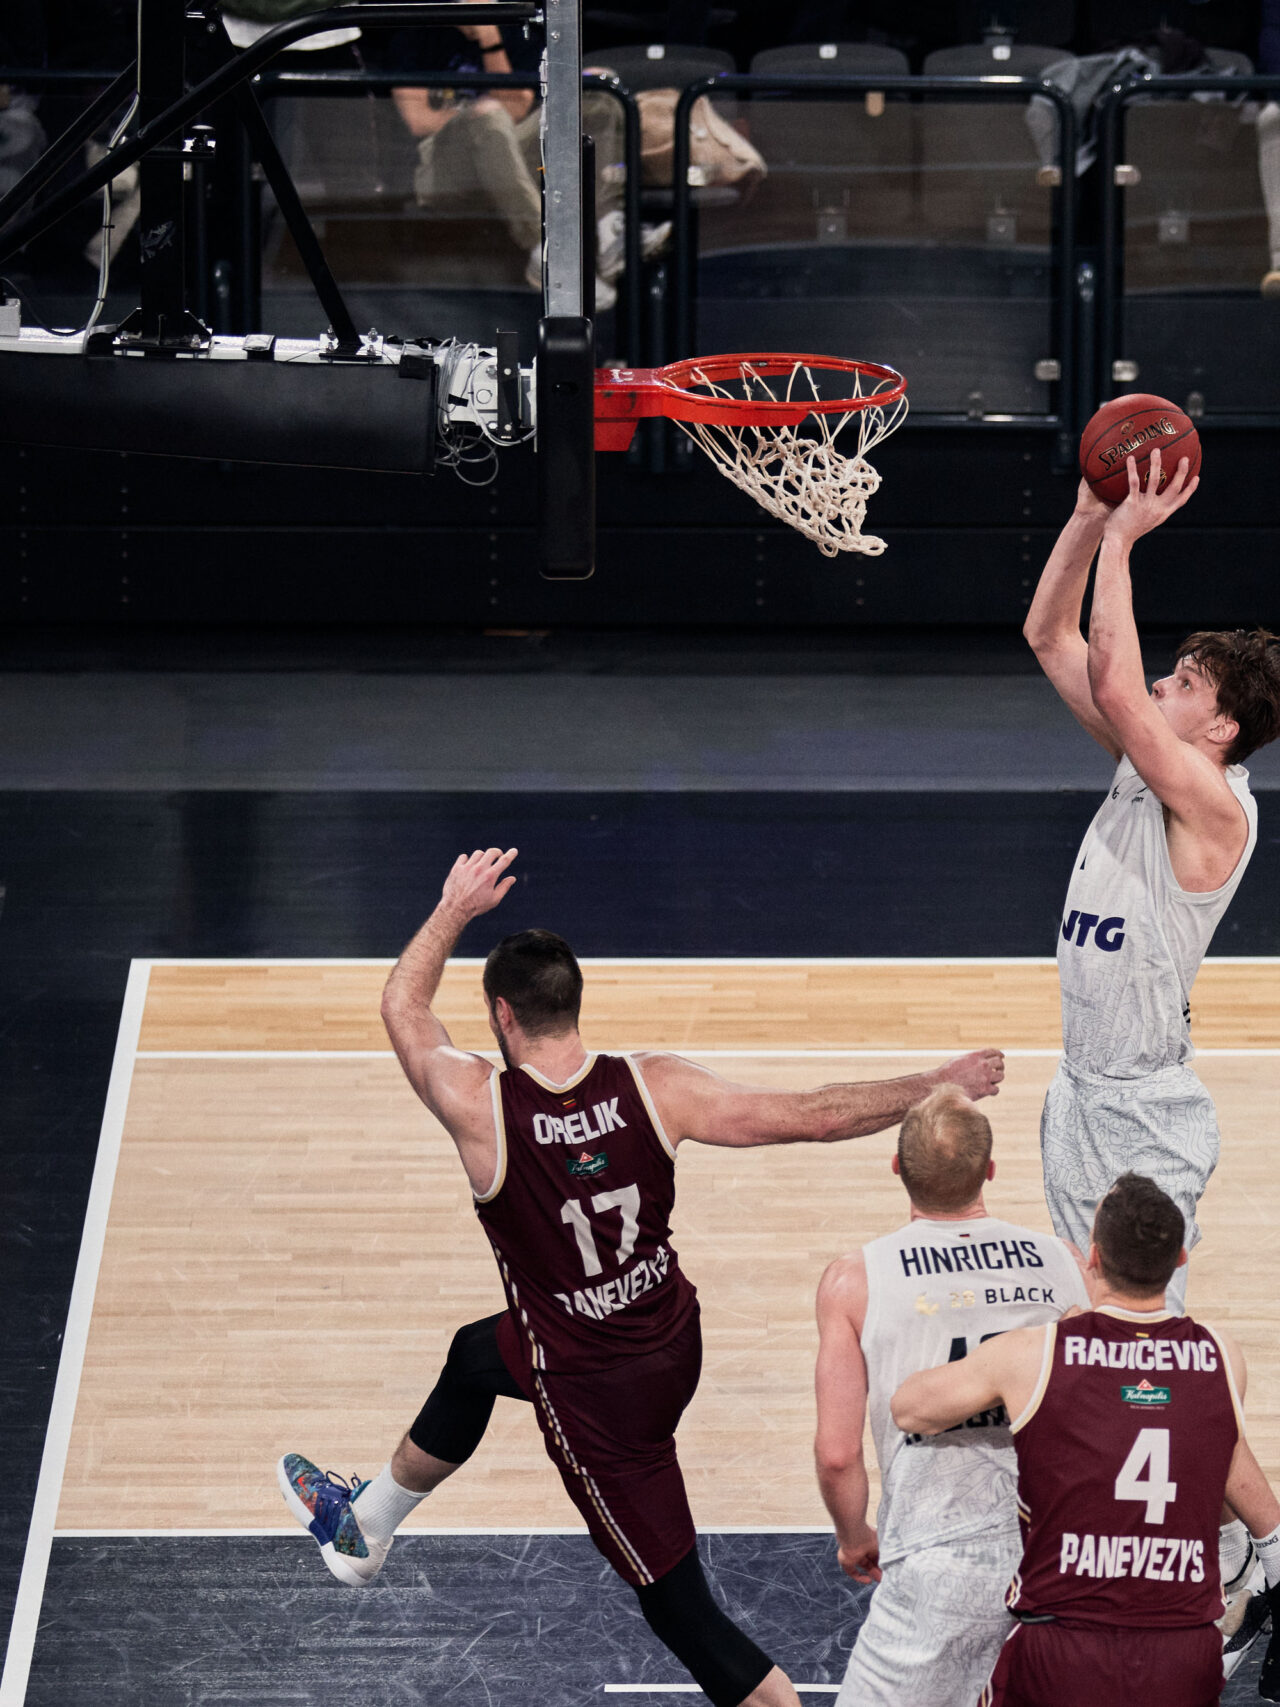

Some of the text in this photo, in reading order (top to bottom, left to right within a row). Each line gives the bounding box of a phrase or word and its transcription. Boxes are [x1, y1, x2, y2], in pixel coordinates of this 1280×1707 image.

[1098, 417, 1176, 471] SPALDING
[532, 1096, 628, 1145] ORELIK
[559, 1182, 641, 1278] 17
[900, 1240, 1044, 1277] HINRICHS
[984, 1287, 1055, 1304] BLACK
[1064, 1336, 1218, 1372] RADICEVIC
[1114, 1428, 1178, 1525] 4
[1059, 1533, 1205, 1583] PANEVEZYS
